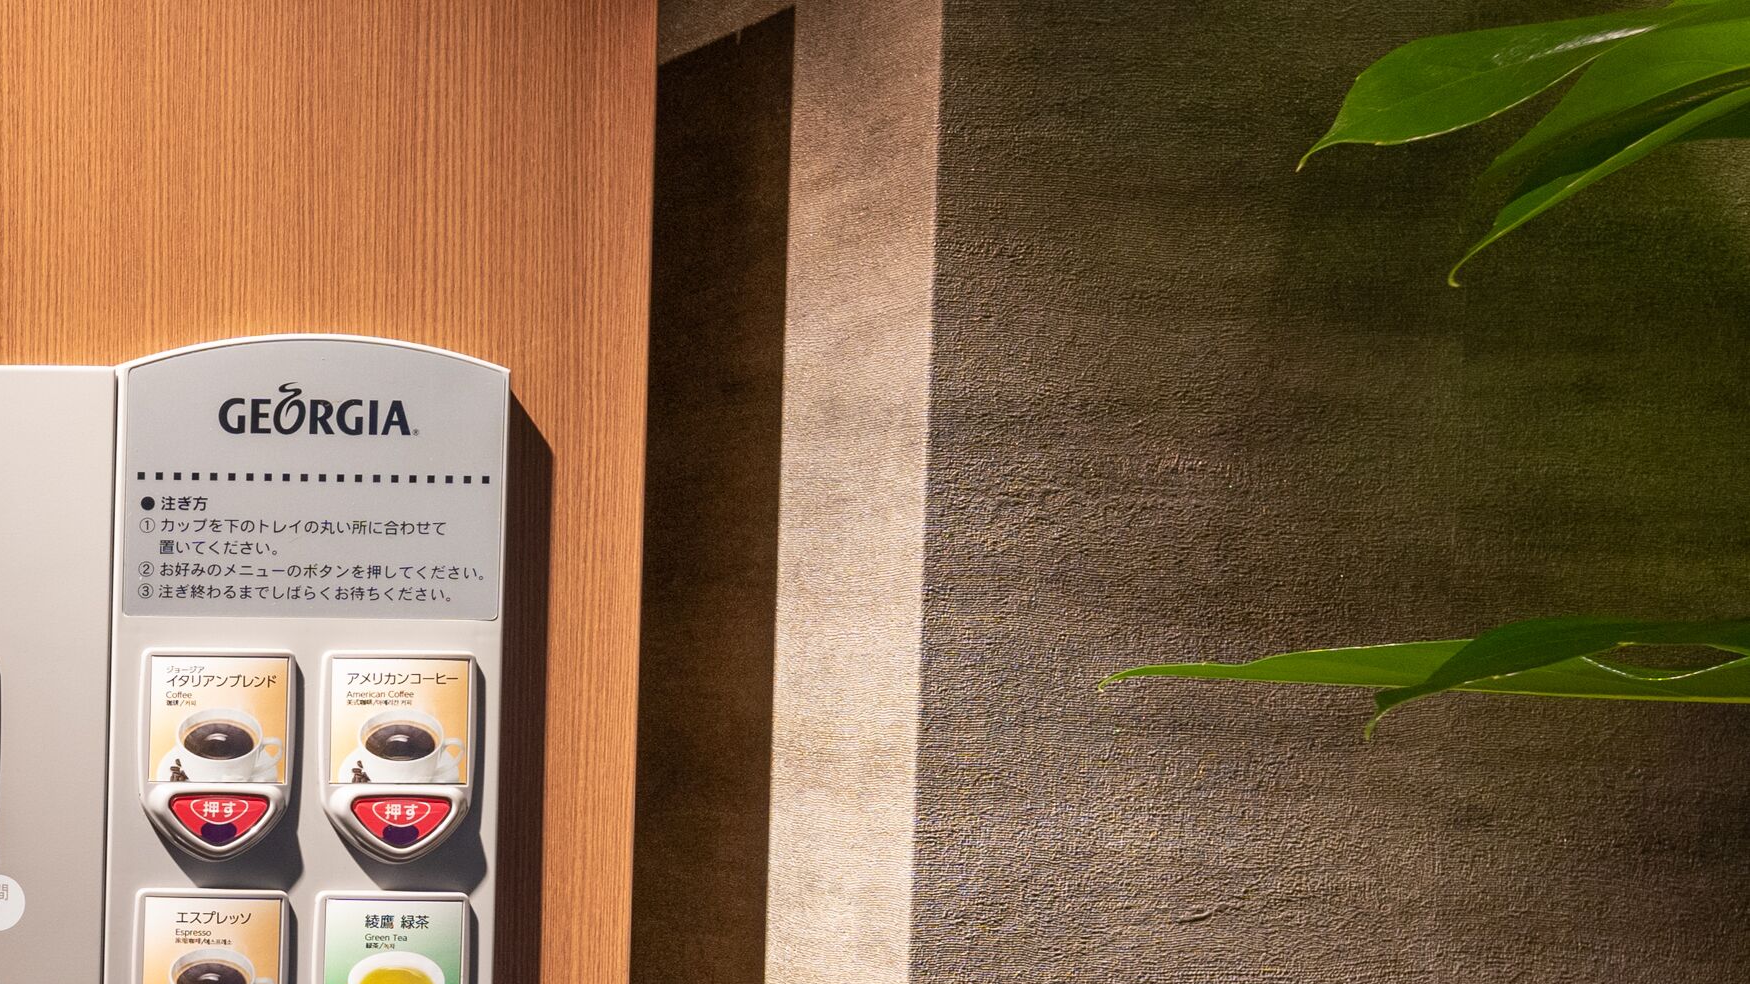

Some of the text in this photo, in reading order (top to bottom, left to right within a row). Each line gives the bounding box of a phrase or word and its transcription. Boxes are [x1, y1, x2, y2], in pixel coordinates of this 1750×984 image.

[218, 382, 411, 436] GEORGIA
[160, 496, 208, 512] 注ぎ方
[159, 540, 279, 556] 置いてください。
[166, 675, 277, 688] イタリアンブレンド
[346, 672, 459, 686] アメリカンコーヒー
[166, 691, 193, 699] Coffee
[346, 690, 414, 699] American Coffee
[203, 802, 236, 817] 押す
[385, 804, 418, 820] 押す
[175, 911, 252, 925] エスプレッソ
[365, 914, 430, 930] 綾鷹 緑茶
[175, 928, 212, 937] Espresso
[365, 933, 408, 942] Green Tea
